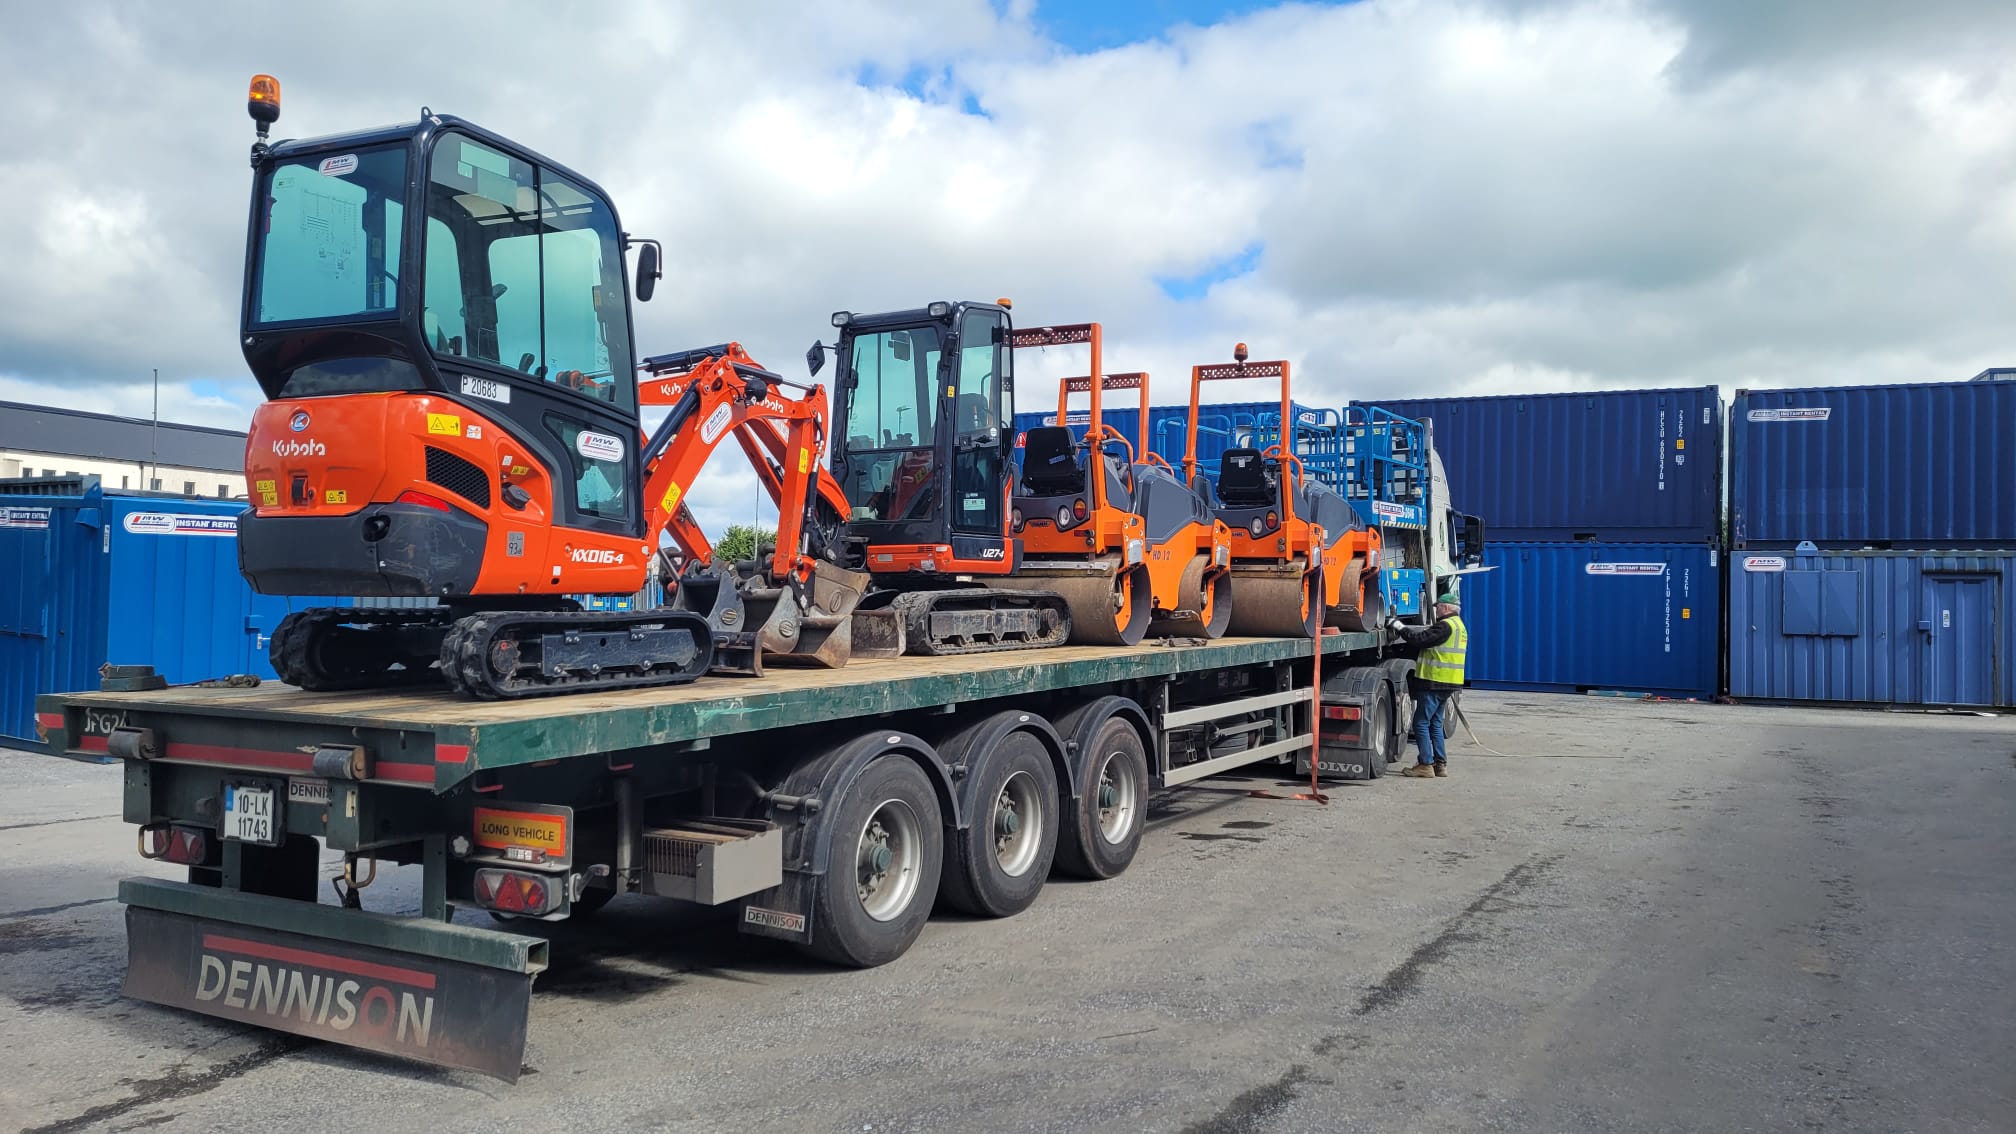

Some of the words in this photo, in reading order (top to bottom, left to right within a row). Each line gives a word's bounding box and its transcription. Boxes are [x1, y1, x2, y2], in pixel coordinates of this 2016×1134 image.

[462, 375, 469, 392] P
[471, 378, 497, 399] 20683
[272, 438, 326, 457] Kubota
[592, 437, 614, 446] MW
[176, 519, 210, 528] INSTANT
[210, 520, 237, 529] RENTA
[571, 548, 625, 565] KX016-4
[982, 548, 1005, 559] U27-4
[1153, 550, 1161, 561] HD
[1163, 550, 1171, 561] 12
[1302, 759, 1364, 774] VOLVO
[290, 783, 329, 799] DENNI
[238, 794, 269, 817] 10-LK
[237, 816, 268, 839] 11743
[482, 823, 510, 837] LONG
[513, 826, 556, 842] VEHICLE
[747, 911, 804, 930] DENNISON
[195, 954, 435, 1048] DENNISON
